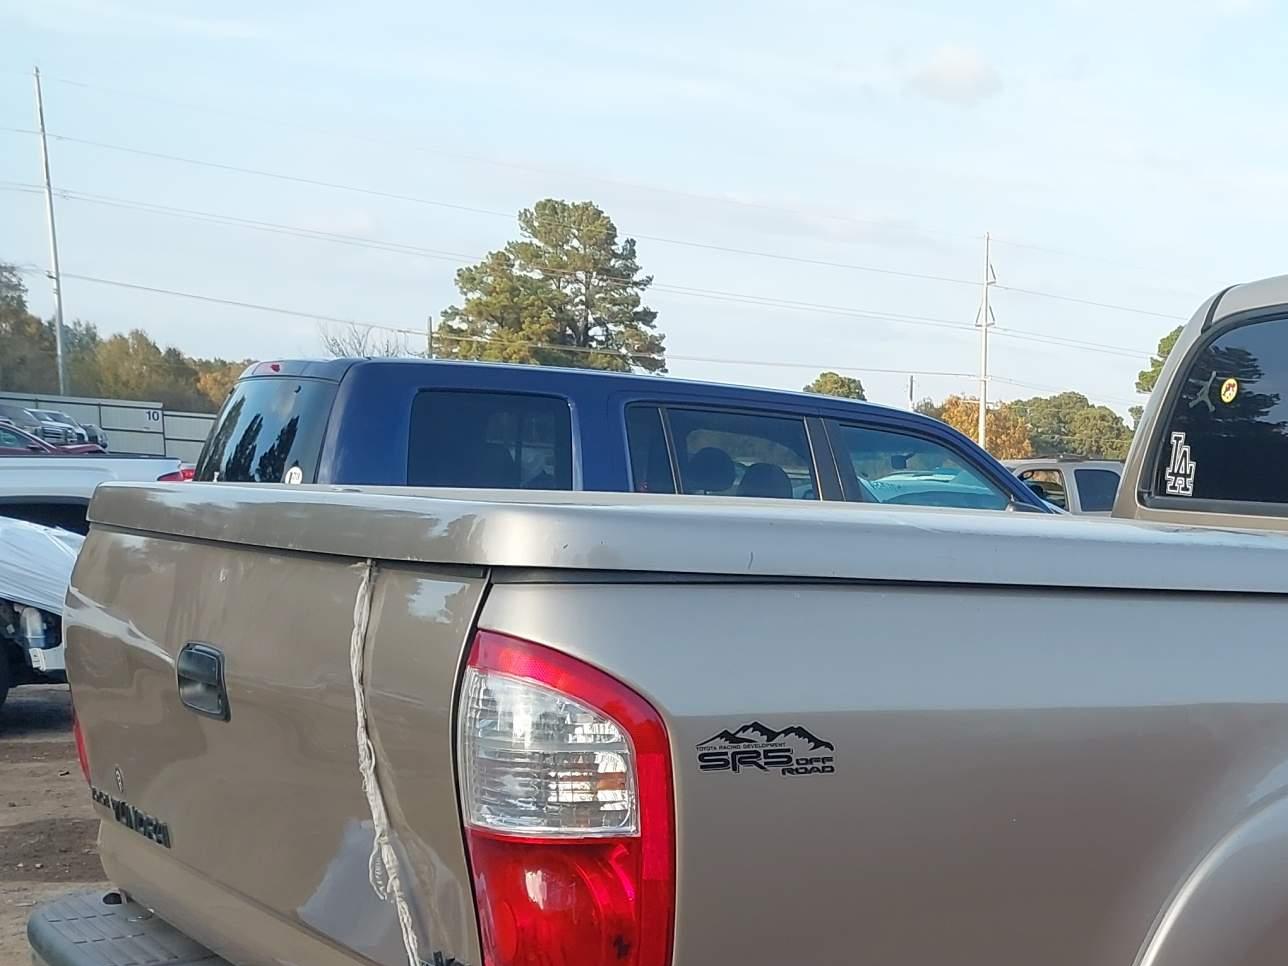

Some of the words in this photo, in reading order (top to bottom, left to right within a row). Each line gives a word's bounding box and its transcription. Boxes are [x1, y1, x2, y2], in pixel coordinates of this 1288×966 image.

[146, 410, 160, 421] 10
[1165, 431, 1197, 497] LA
[742, 741, 786, 749] DEVELOPMENT
[698, 748, 794, 773] SR5
[795, 756, 834, 766] OFF
[781, 765, 835, 776] ROAD
